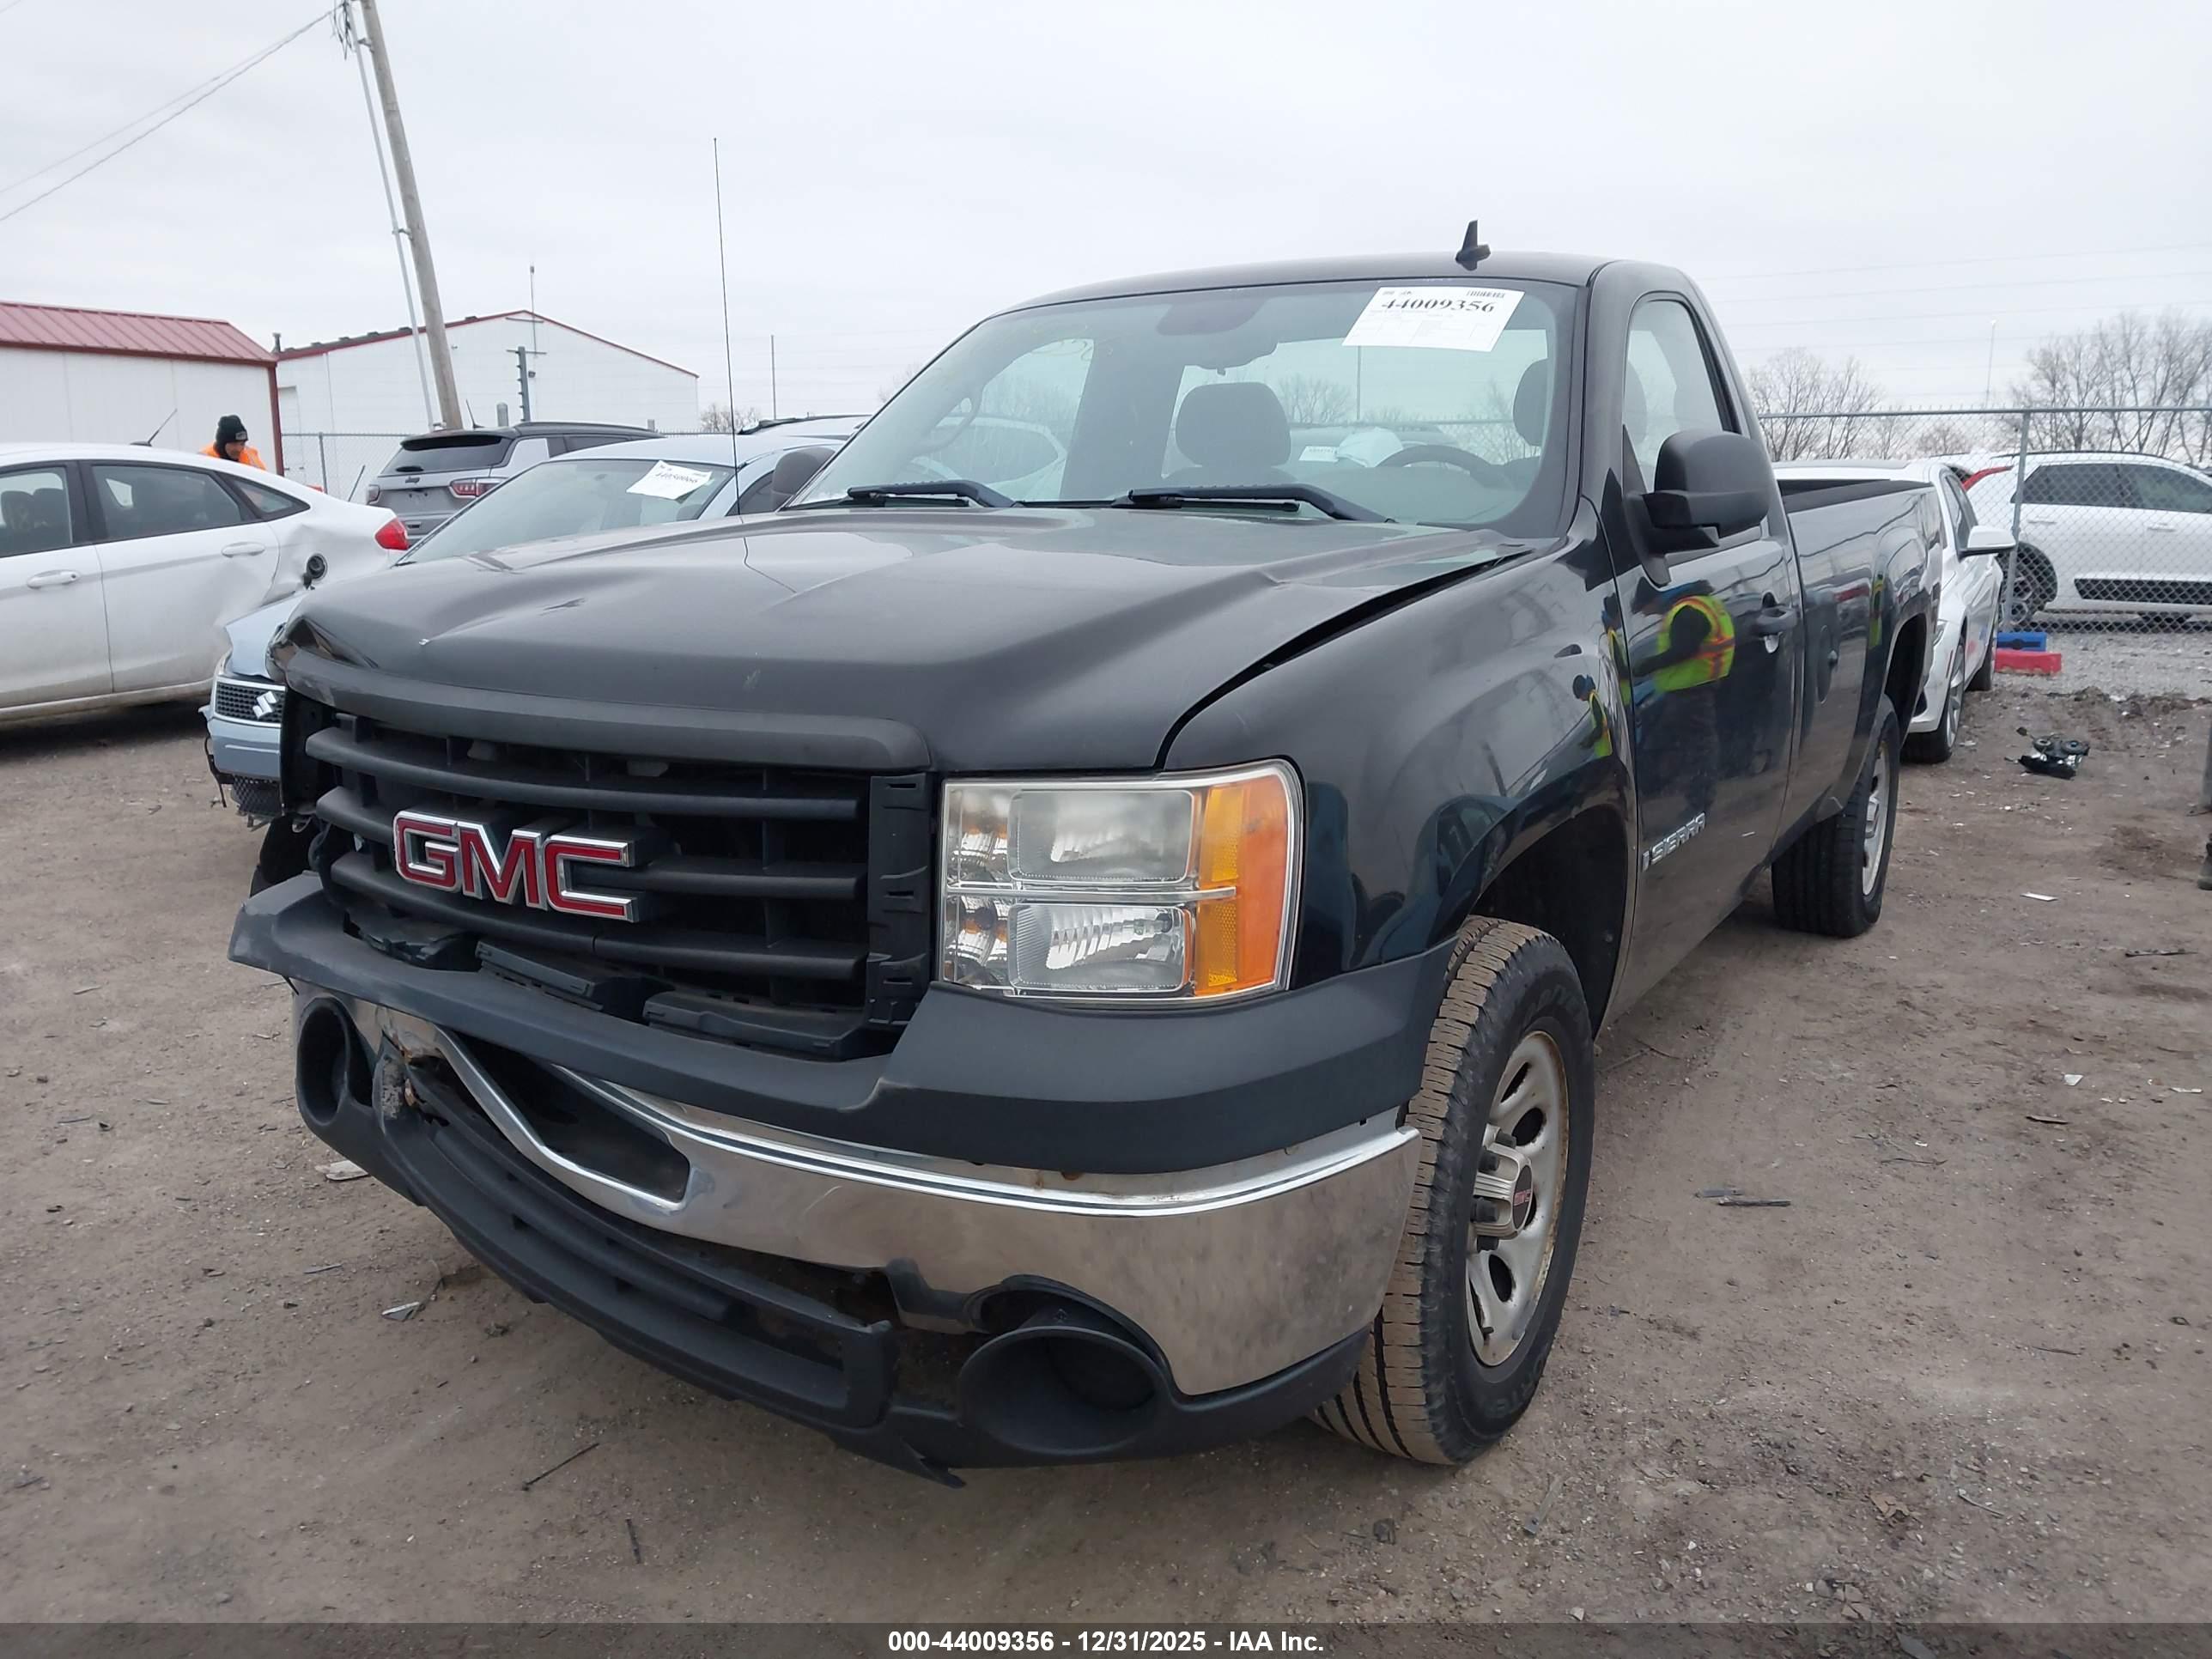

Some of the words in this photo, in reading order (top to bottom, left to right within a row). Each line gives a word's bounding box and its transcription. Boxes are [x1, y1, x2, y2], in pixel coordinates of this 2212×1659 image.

[1381, 298, 1496, 313] 44009356
[392, 809, 638, 923] GMC
[1650, 811, 1706, 866] SIERRA
